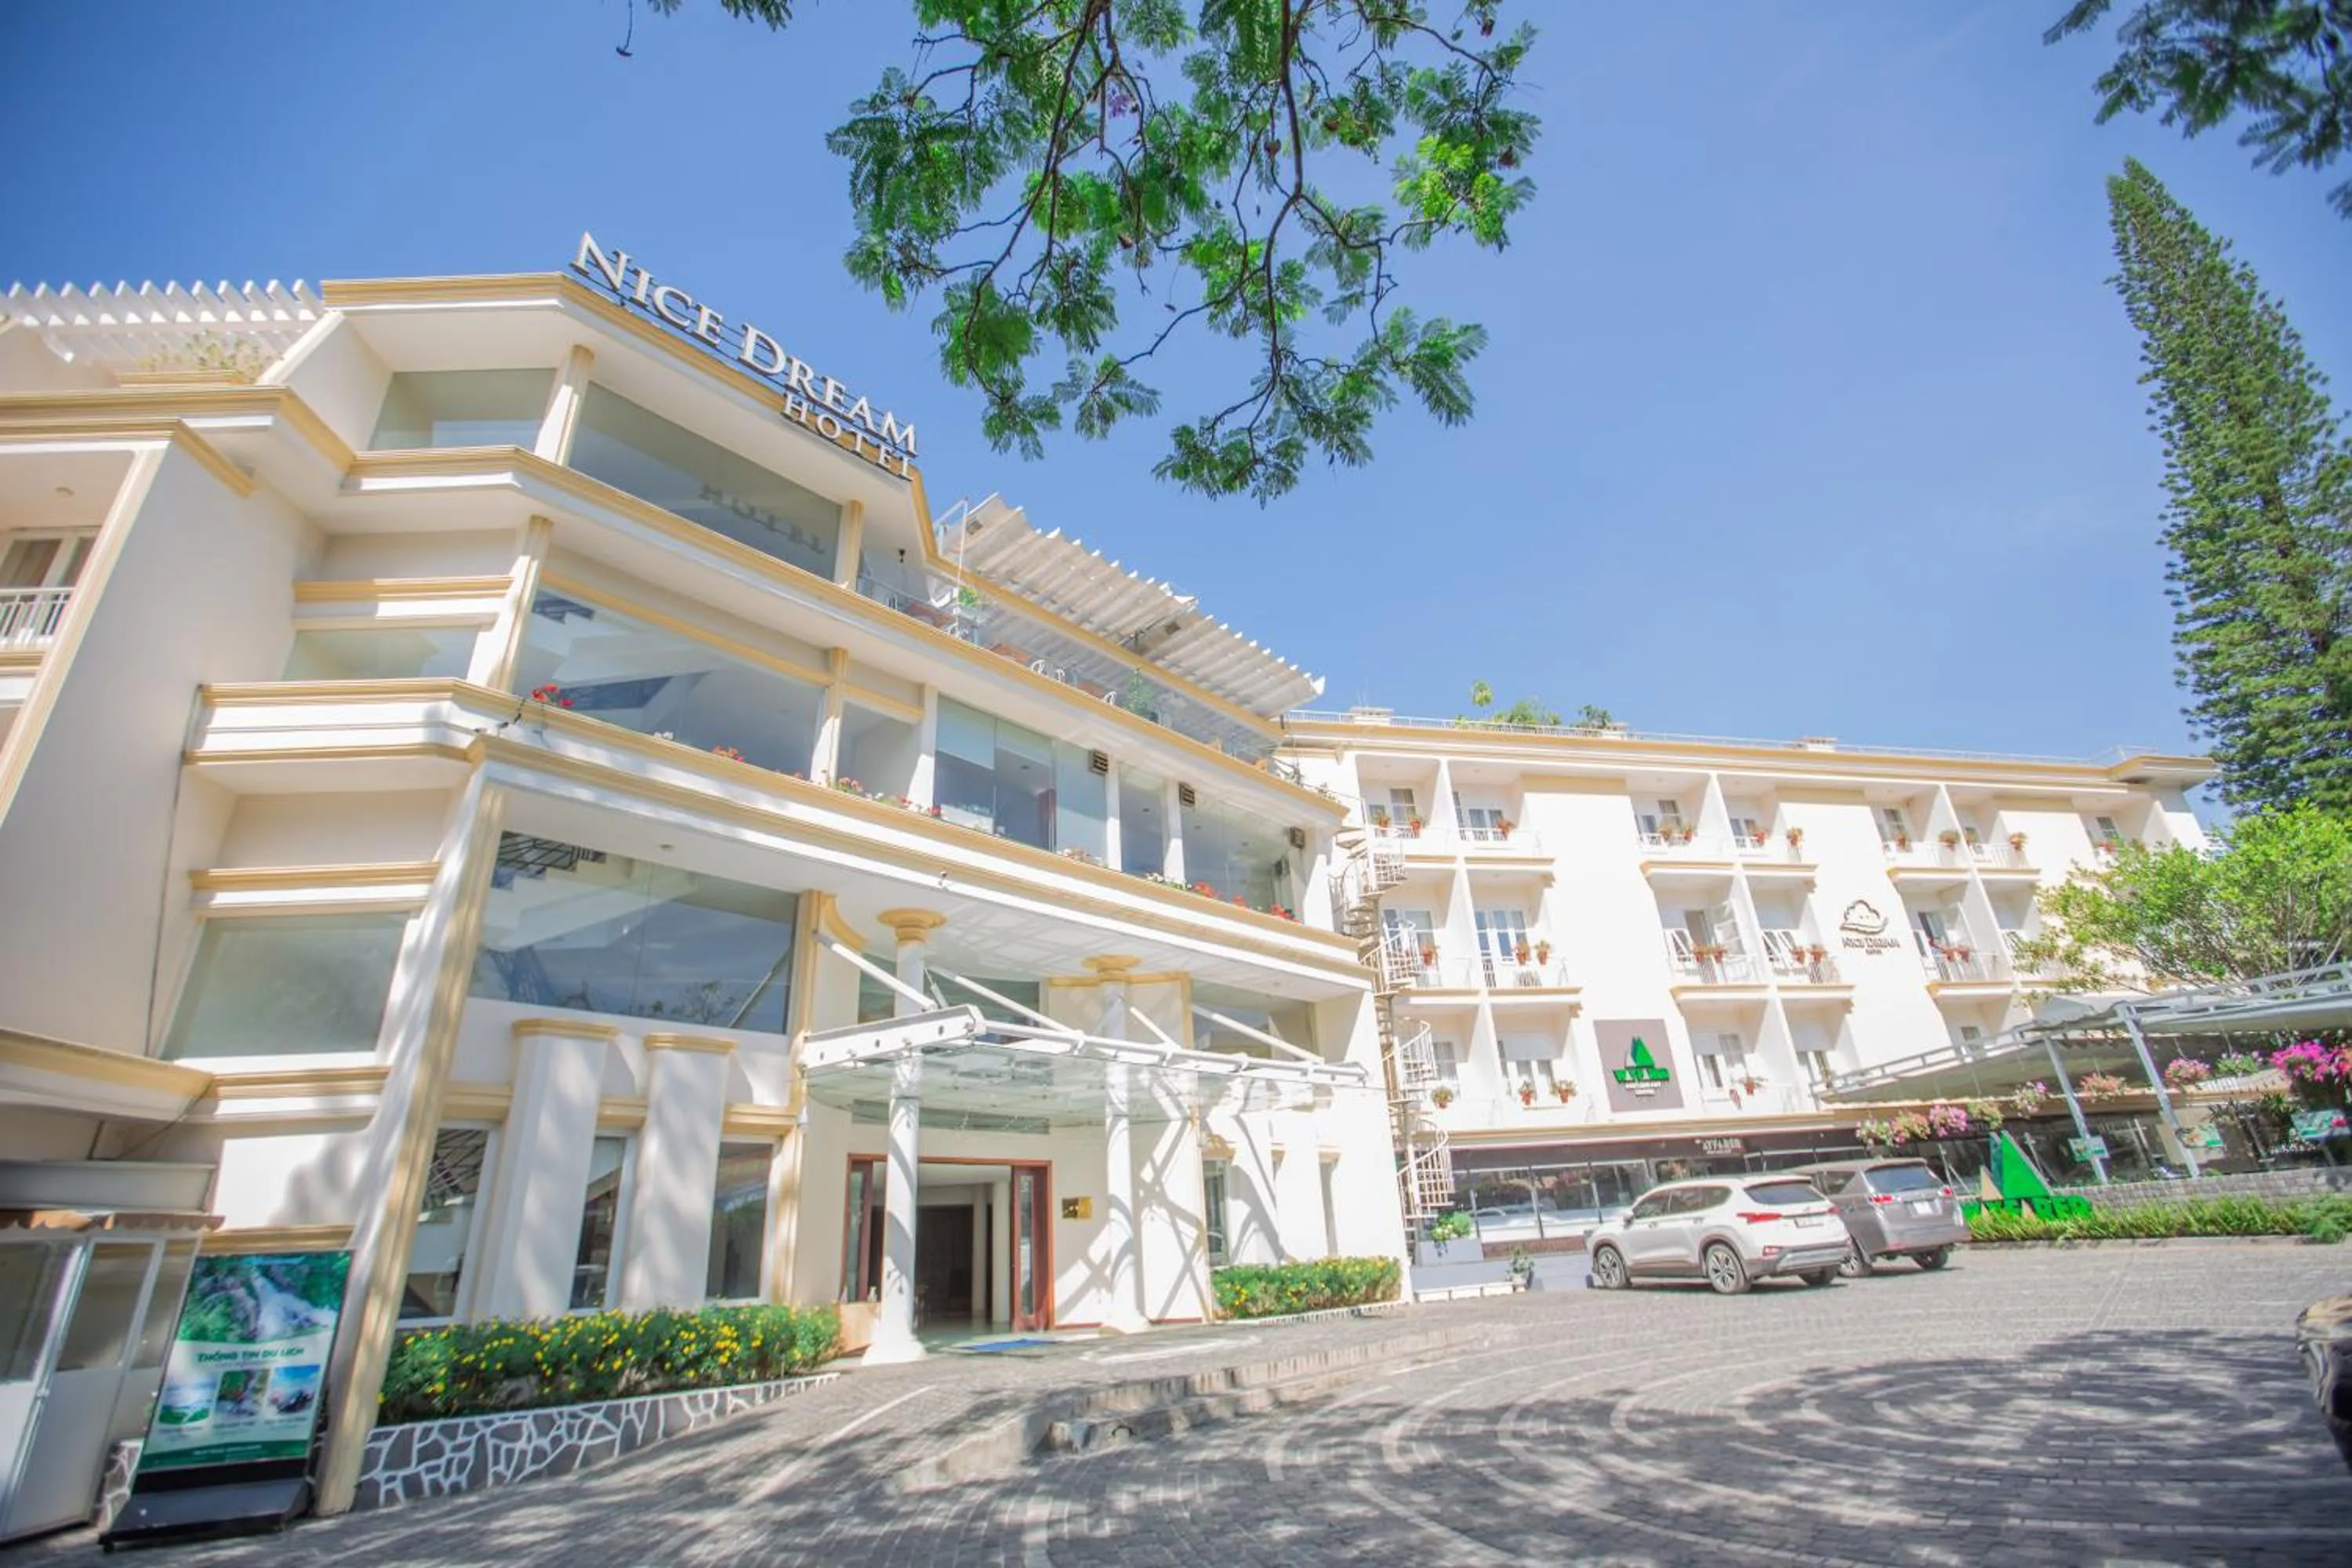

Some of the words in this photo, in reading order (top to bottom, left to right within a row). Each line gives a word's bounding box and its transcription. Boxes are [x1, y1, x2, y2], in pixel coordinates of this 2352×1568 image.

[569, 231, 724, 347] NICE
[738, 322, 918, 456] DREAM
[781, 392, 914, 481] HOTEL
